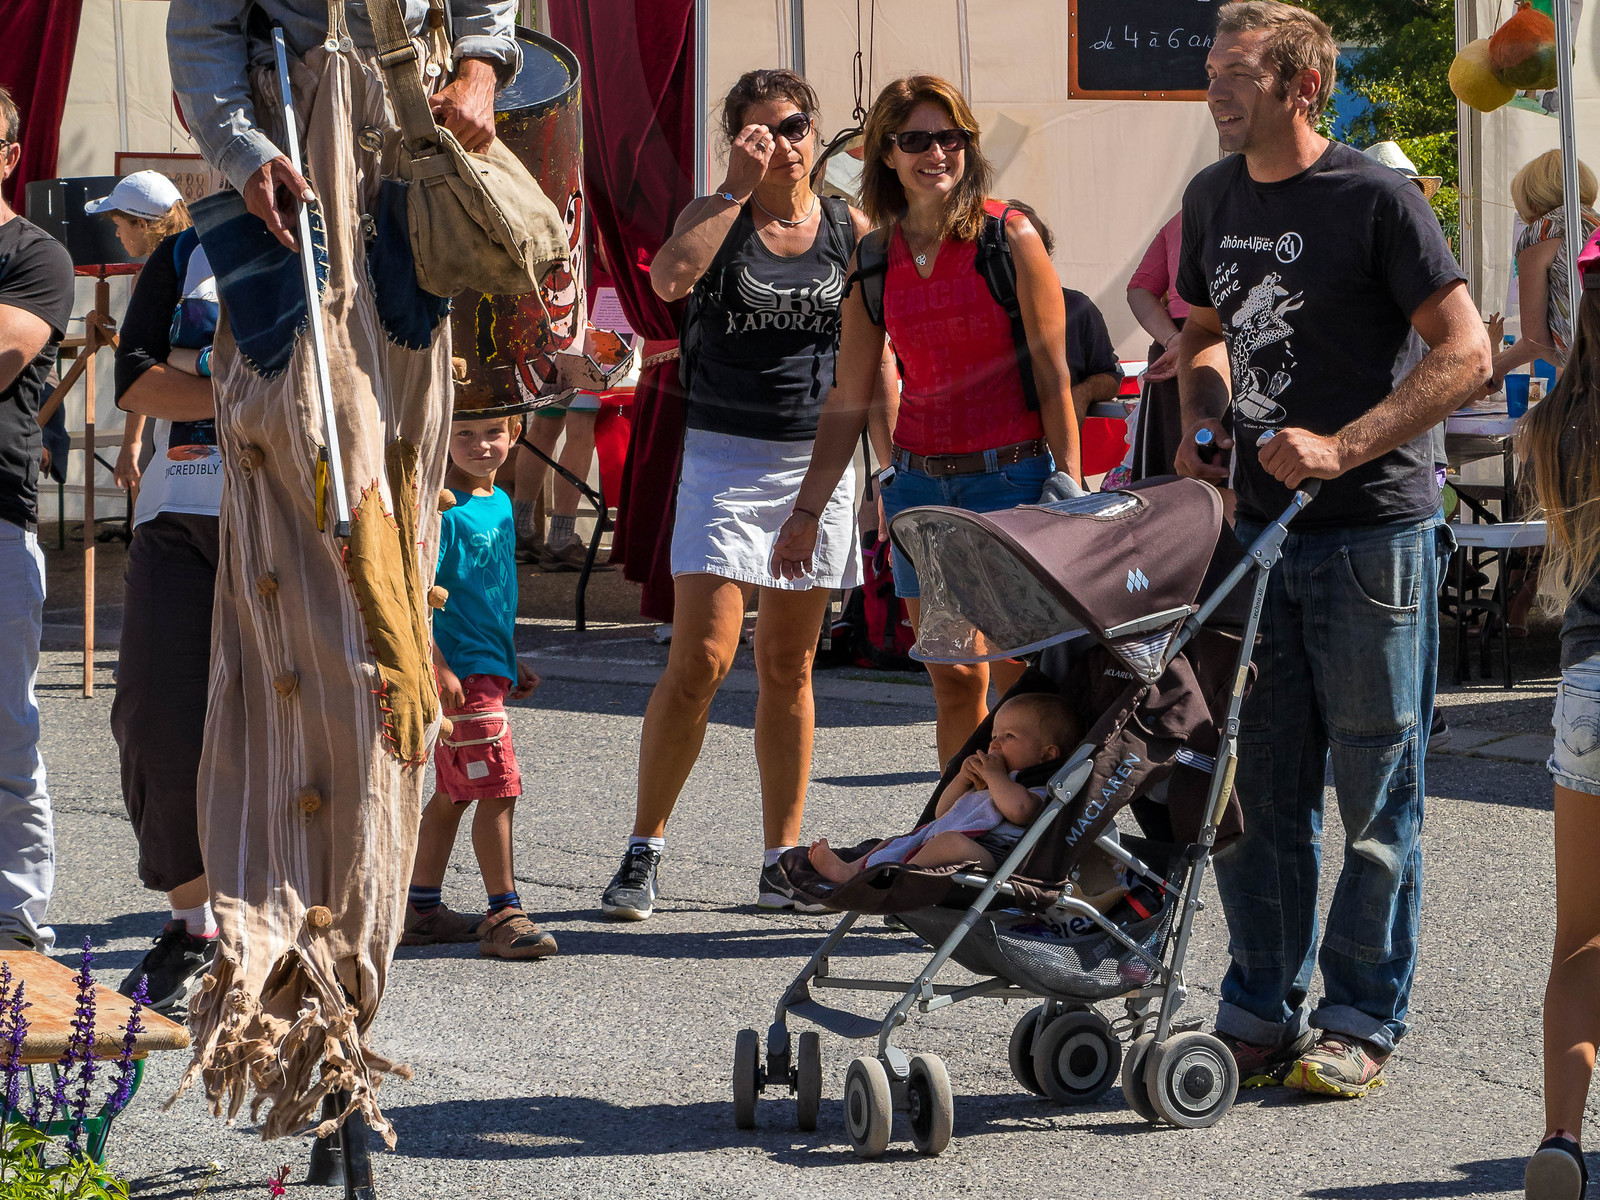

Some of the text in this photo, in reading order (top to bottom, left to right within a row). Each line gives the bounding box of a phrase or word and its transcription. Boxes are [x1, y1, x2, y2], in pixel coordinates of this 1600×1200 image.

[1089, 26, 1116, 50] de
[1124, 25, 1139, 49] 4
[1168, 28, 1185, 49] 6
[1210, 262, 1239, 297] Coupe
[1252, 597, 1262, 620] techno
[1065, 752, 1141, 847] MACLAREN
